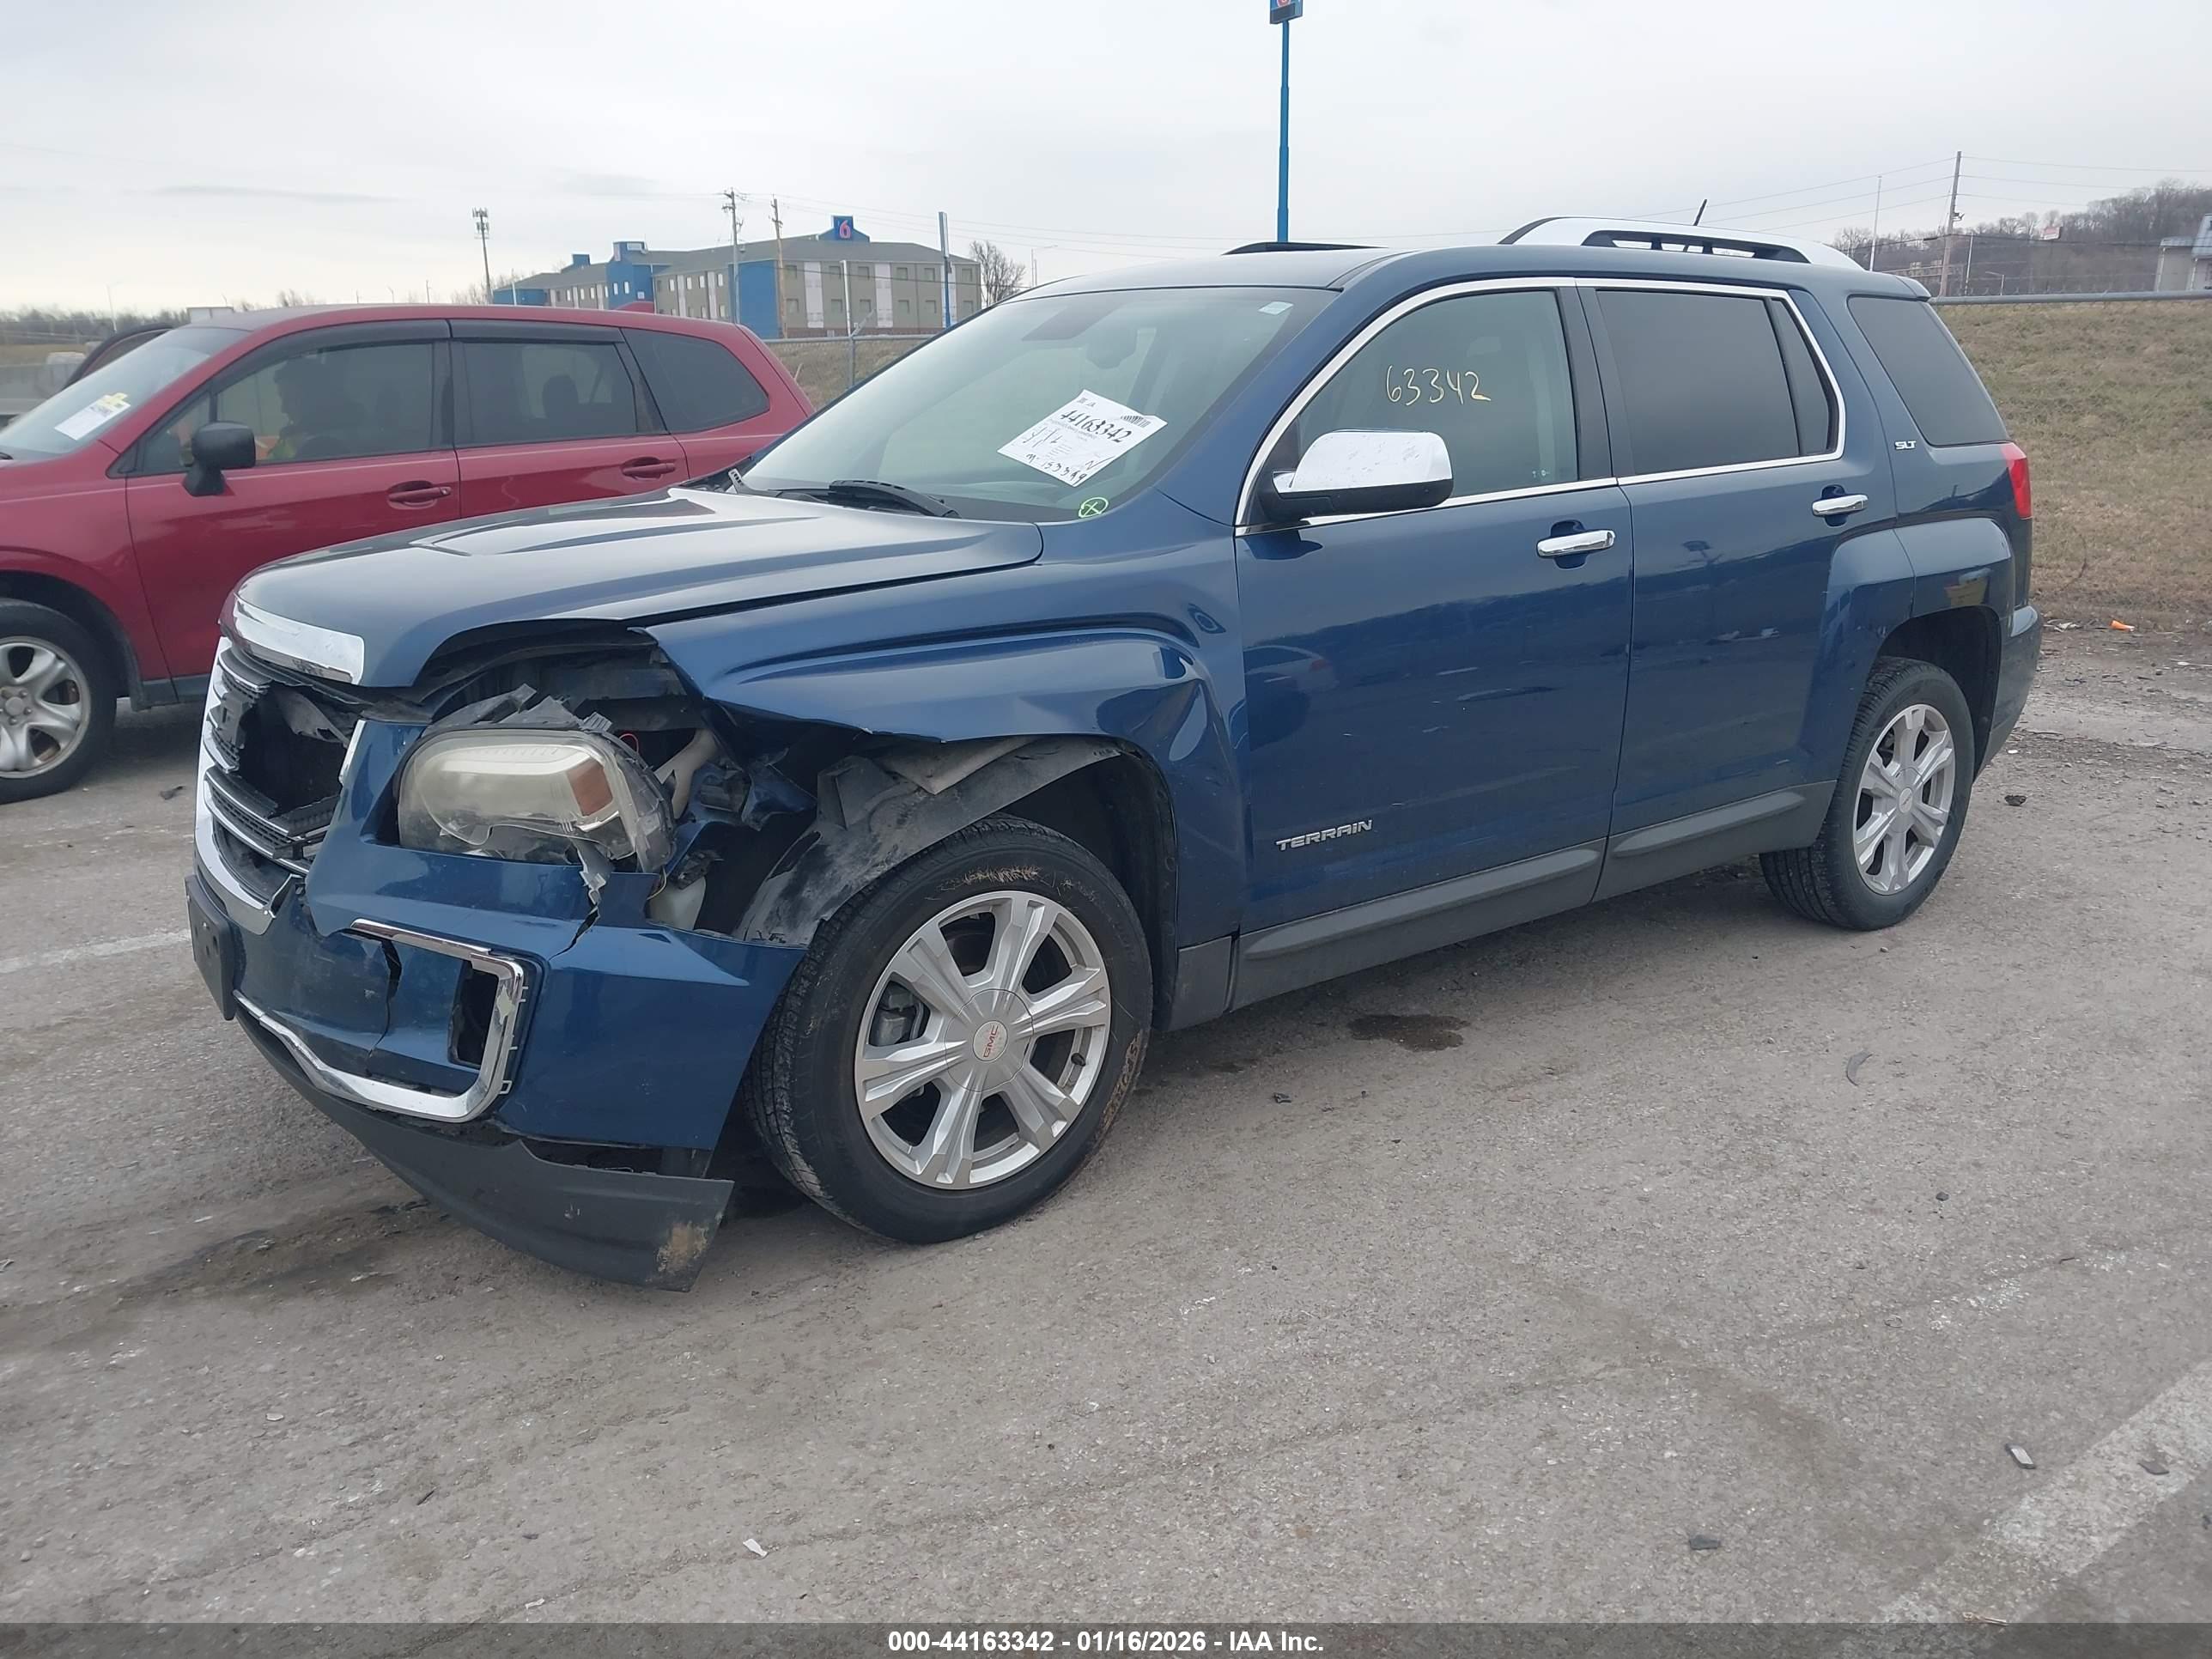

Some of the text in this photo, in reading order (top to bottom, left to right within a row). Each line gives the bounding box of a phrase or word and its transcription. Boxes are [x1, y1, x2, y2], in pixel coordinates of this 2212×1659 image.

[840, 219, 851, 239] 6
[1386, 365, 1492, 406] 63342
[1060, 410, 1132, 443] 44163342
[1895, 441, 1917, 450] SLT
[1275, 819, 1372, 851] TERRAIN
[982, 1024, 999, 1058] GMC
